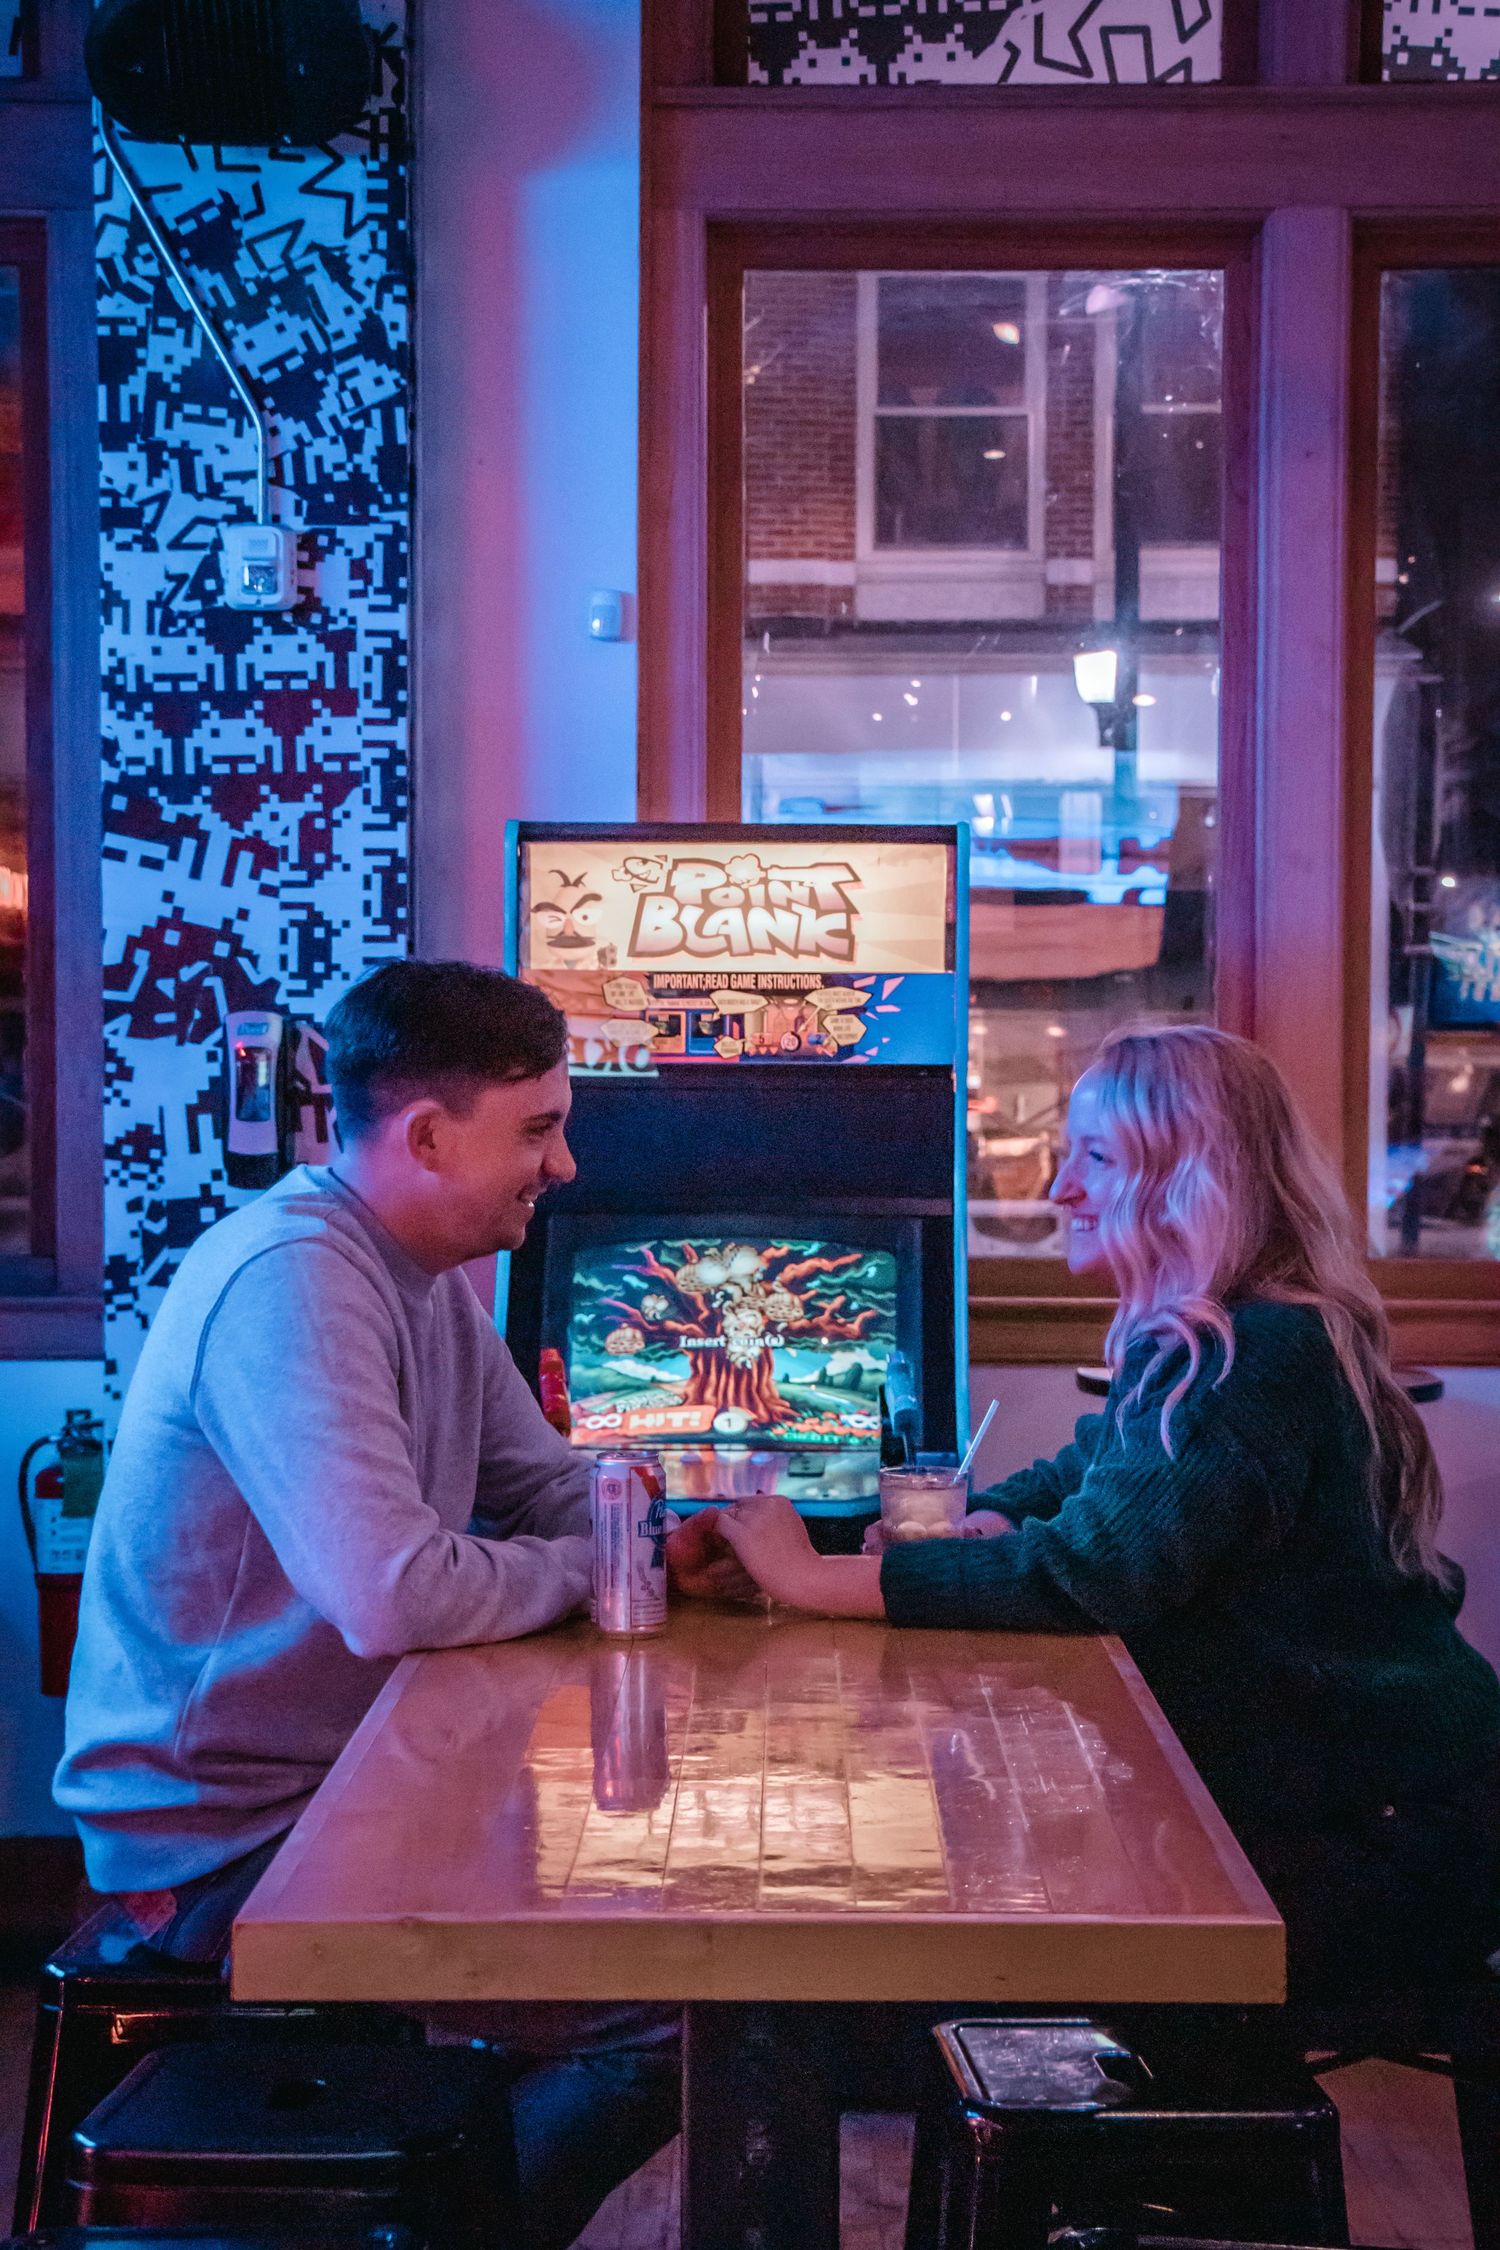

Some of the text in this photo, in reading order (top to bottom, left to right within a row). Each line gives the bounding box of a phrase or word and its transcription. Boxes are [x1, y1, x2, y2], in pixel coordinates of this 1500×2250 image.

[730, 974, 756, 989] GAME
[757, 974, 825, 989] INSTRUCTIONS.
[679, 1335, 726, 1348] Insert
[629, 1410, 702, 1430] HIT!
